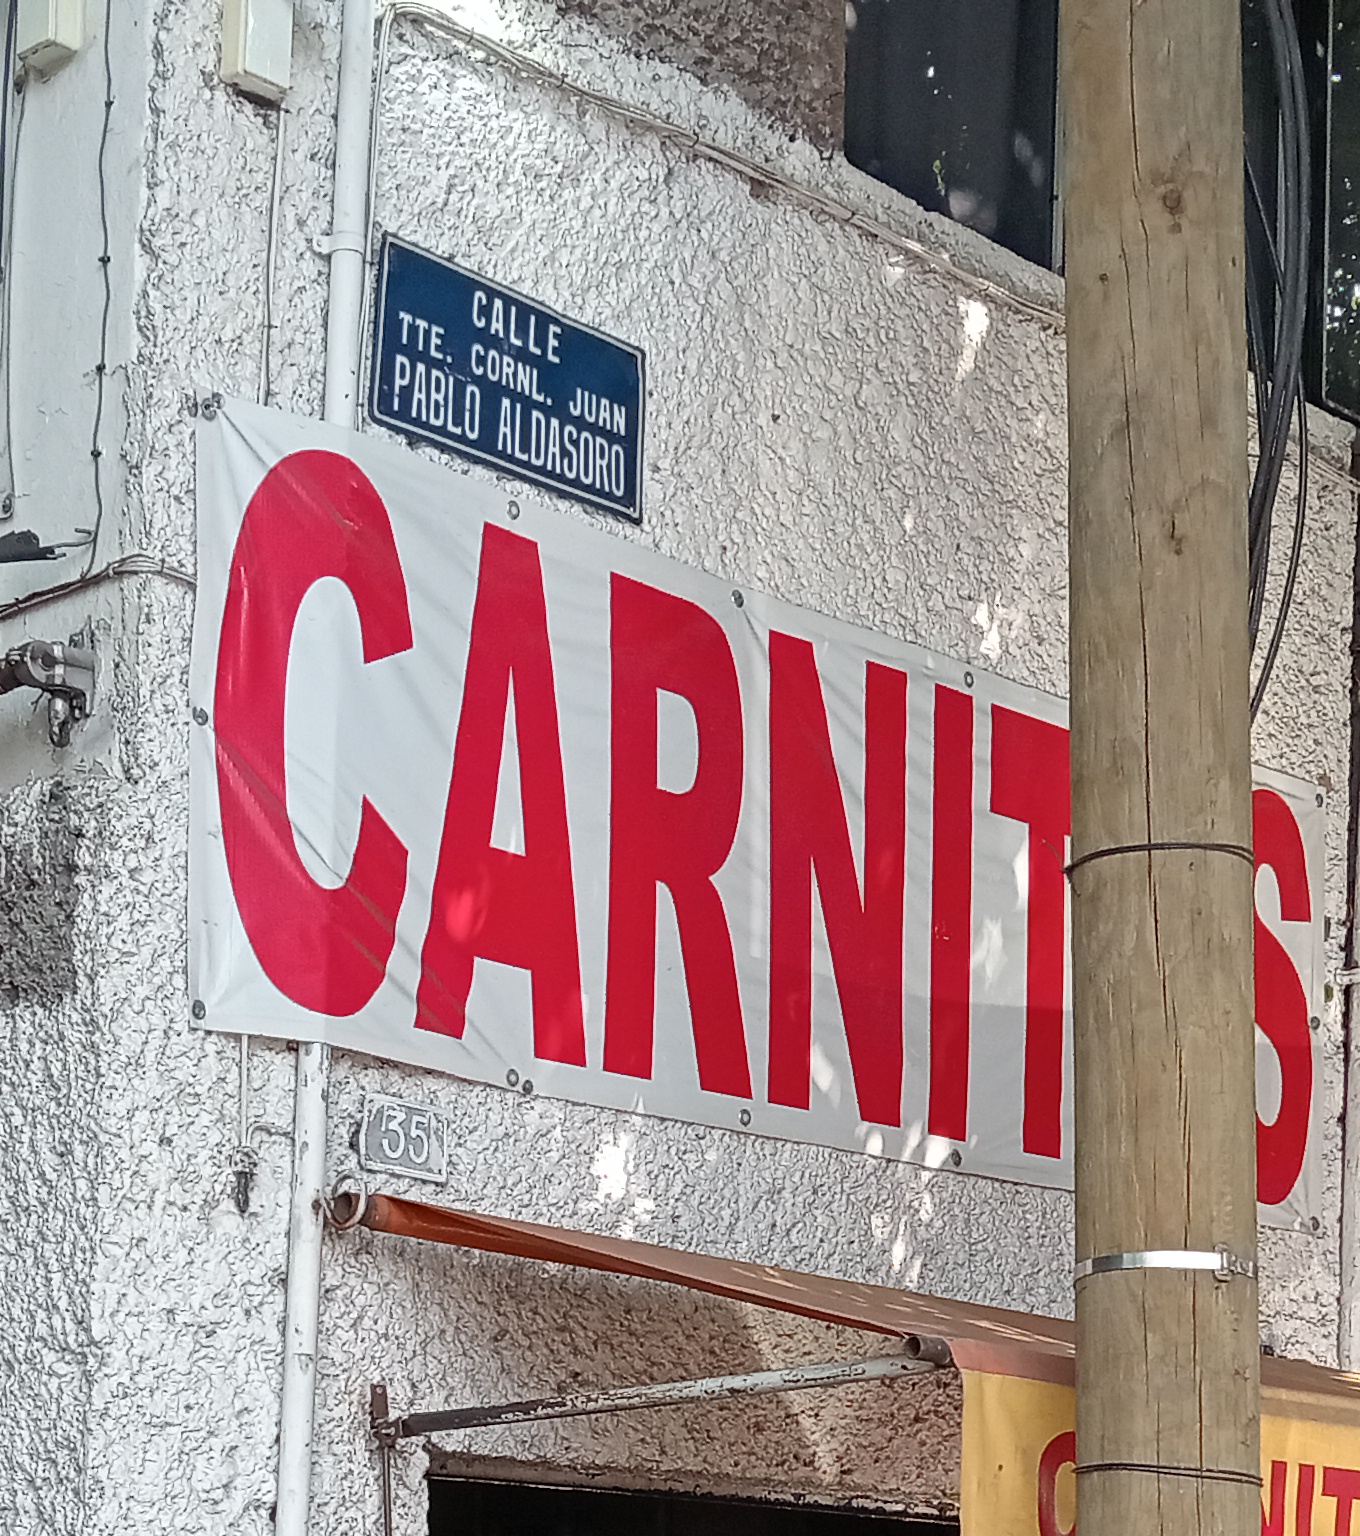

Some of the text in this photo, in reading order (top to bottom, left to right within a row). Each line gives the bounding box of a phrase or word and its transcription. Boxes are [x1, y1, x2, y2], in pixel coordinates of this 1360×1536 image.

[398, 310, 626, 436] TTE. CORNL. JUAN
[472, 290, 562, 363] CALLE
[393, 354, 625, 497] PABLO ALDASORO
[214, 449, 1313, 1205] CARNITS
[381, 1104, 429, 1165] 35
